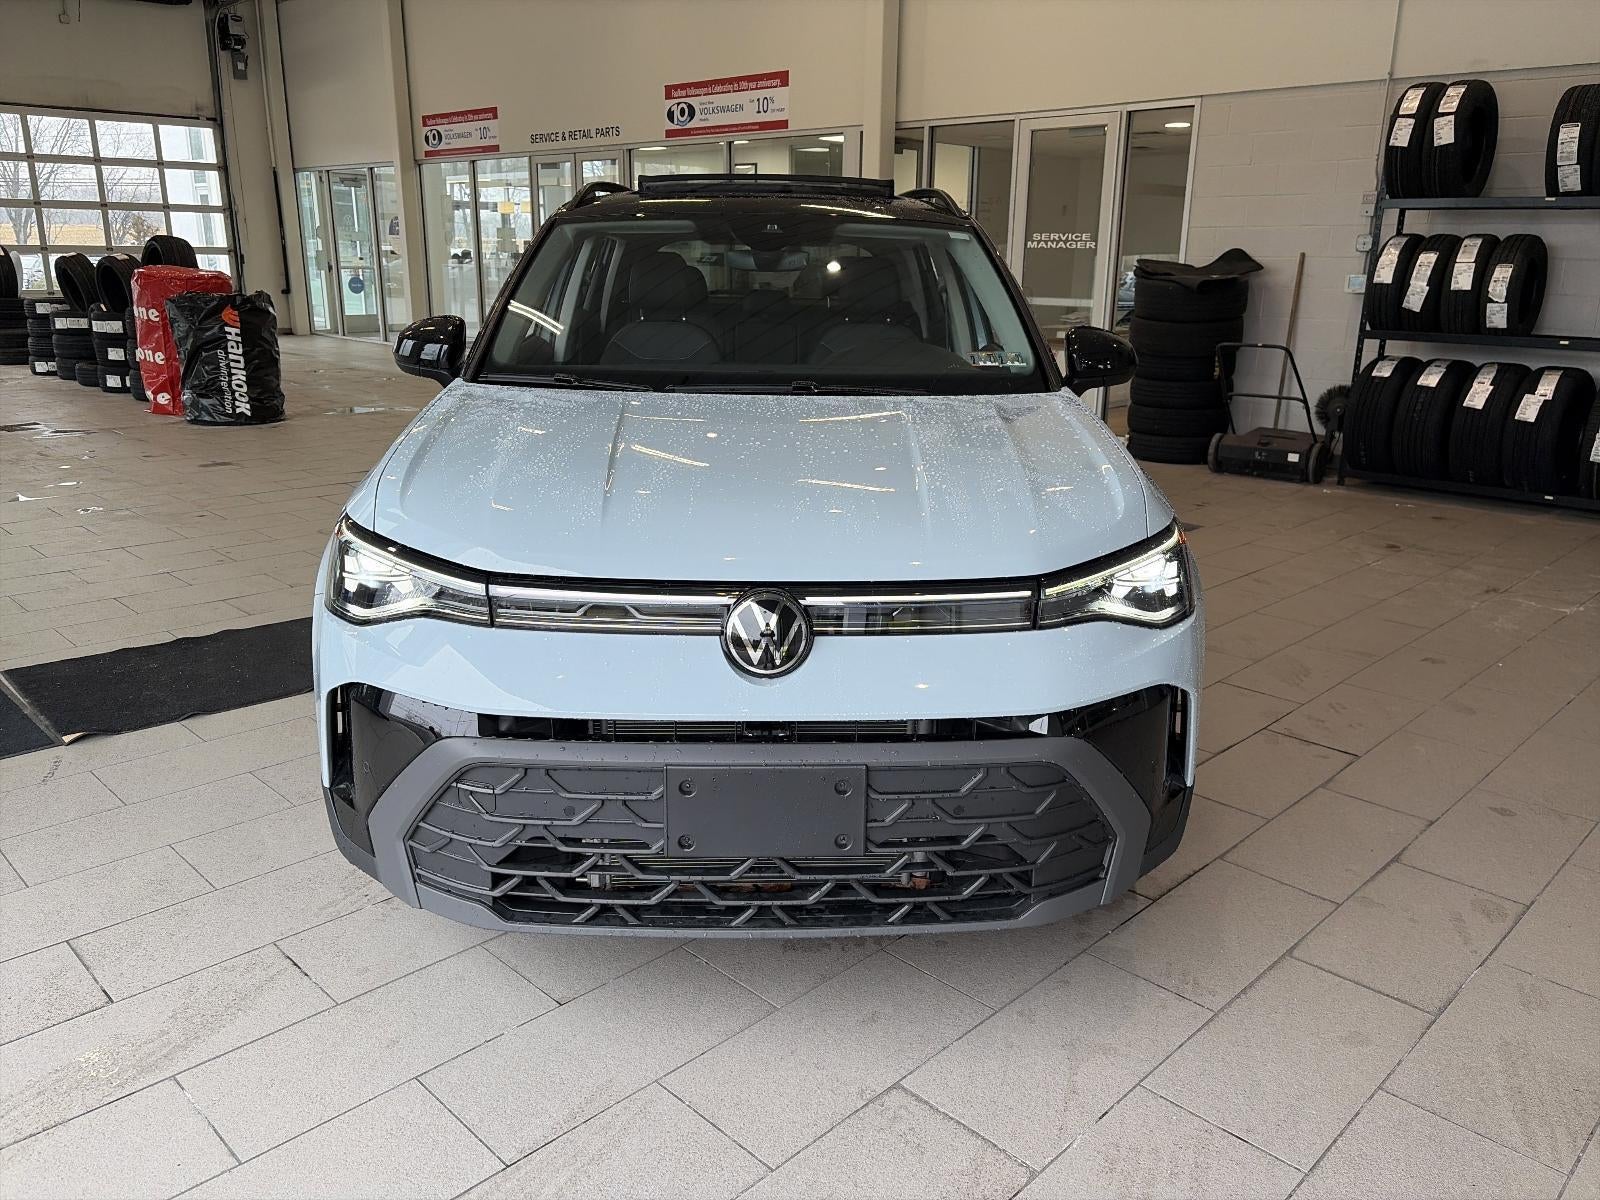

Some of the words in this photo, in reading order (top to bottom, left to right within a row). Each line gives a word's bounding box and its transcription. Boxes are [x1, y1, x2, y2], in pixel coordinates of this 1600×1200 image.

[699, 103, 744, 116] VOLKSWAGEN
[530, 131, 559, 144] SERVICE
[561, 131, 566, 141] &
[568, 128, 593, 141] RETAIL
[595, 126, 620, 138] PARTS
[1032, 232, 1091, 241] SERVICE
[1027, 241, 1096, 249] MANAGER
